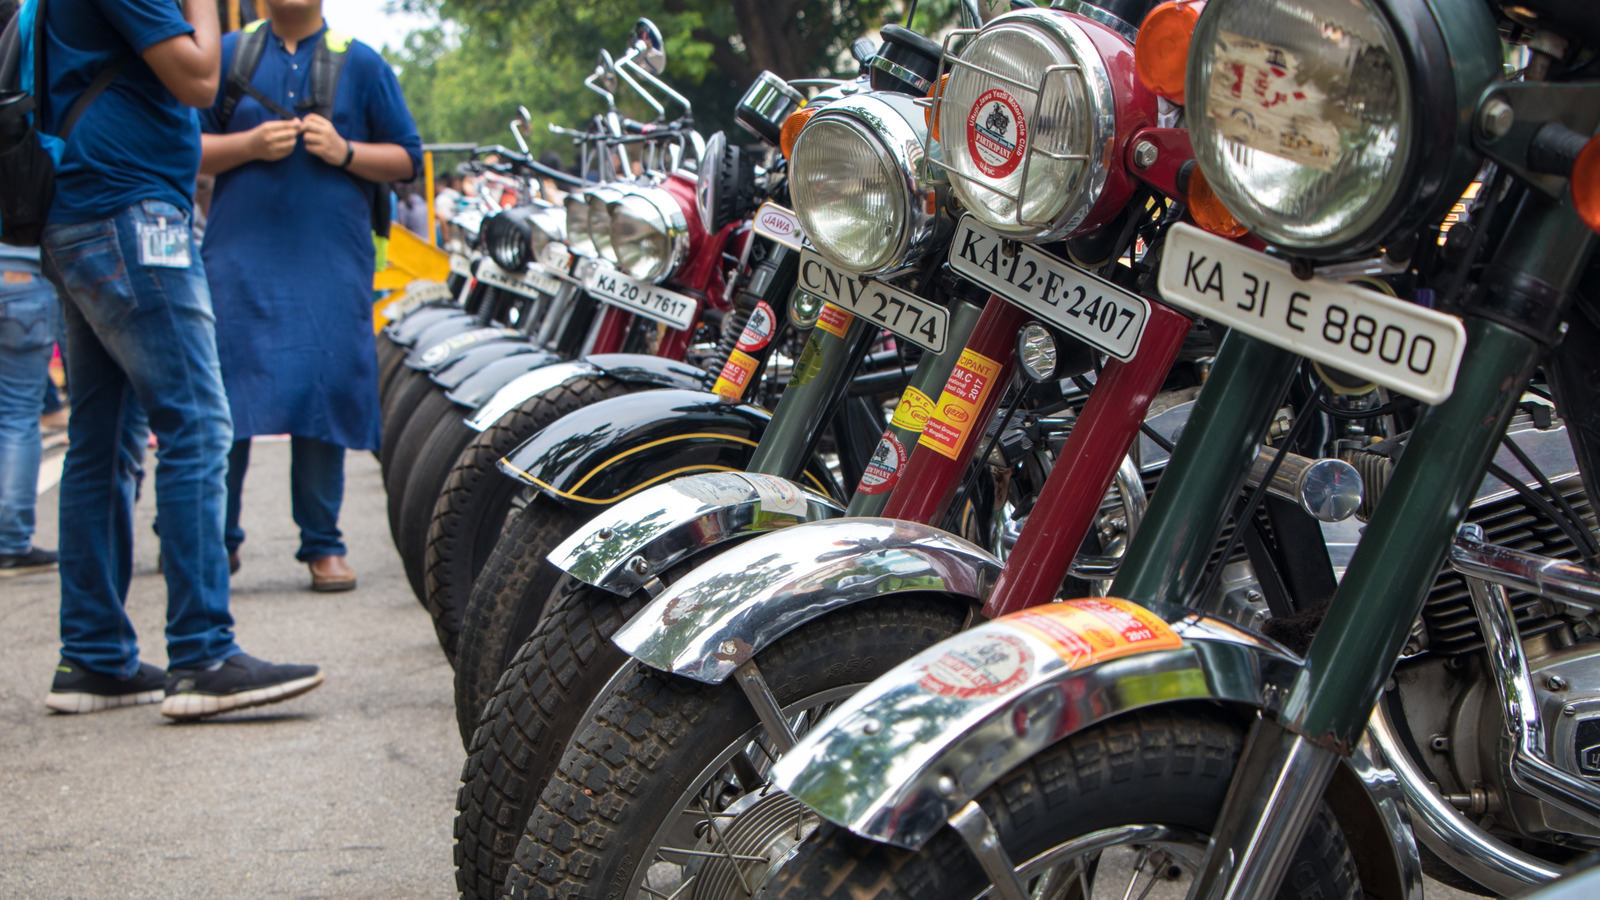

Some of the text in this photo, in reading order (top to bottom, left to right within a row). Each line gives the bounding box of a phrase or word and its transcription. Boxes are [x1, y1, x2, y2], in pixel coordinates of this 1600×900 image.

[979, 95, 992, 106] Jawa
[1008, 96, 1025, 136] Motorcycle
[1017, 138, 1026, 157] Club
[975, 132, 1012, 159] PARTICIPANT
[764, 214, 790, 233] JAWA
[597, 274, 688, 318] KA 20 J 7617
[802, 259, 937, 344] CNV 2774
[1184, 251, 1225, 302] KA
[1286, 291, 1311, 332] E
[1322, 304, 1436, 375] 8800
[960, 356, 992, 376] CIPANT
[968, 378, 983, 401] 2017
